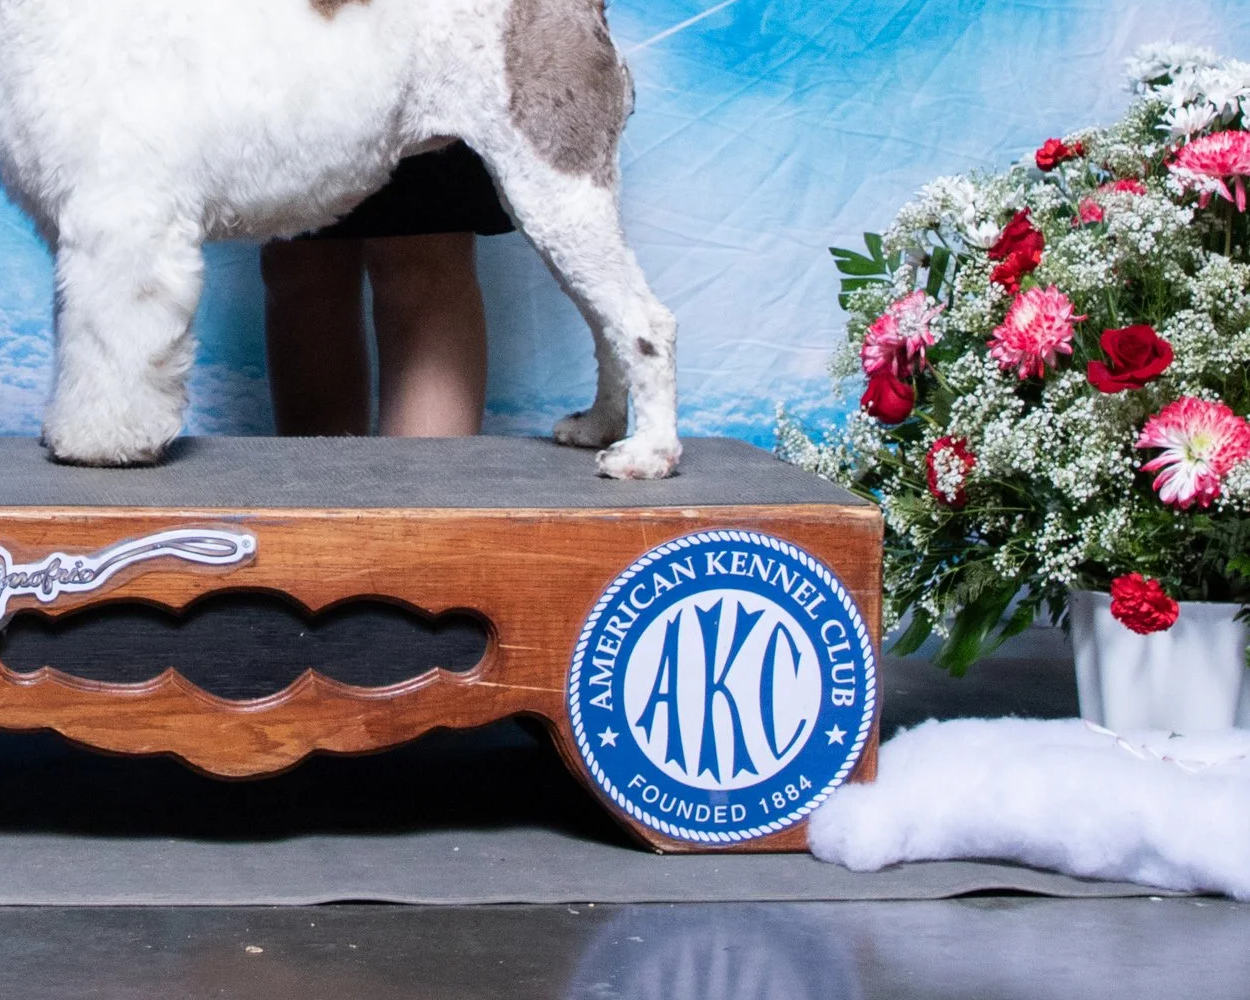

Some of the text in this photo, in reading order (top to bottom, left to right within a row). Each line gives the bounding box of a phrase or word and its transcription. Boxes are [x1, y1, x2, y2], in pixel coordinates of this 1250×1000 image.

[589, 550, 856, 711] AMERICAN KENNEL CLUB
[635, 596, 807, 785] AKC
[628, 774, 813, 824] FOUNDED 1884
